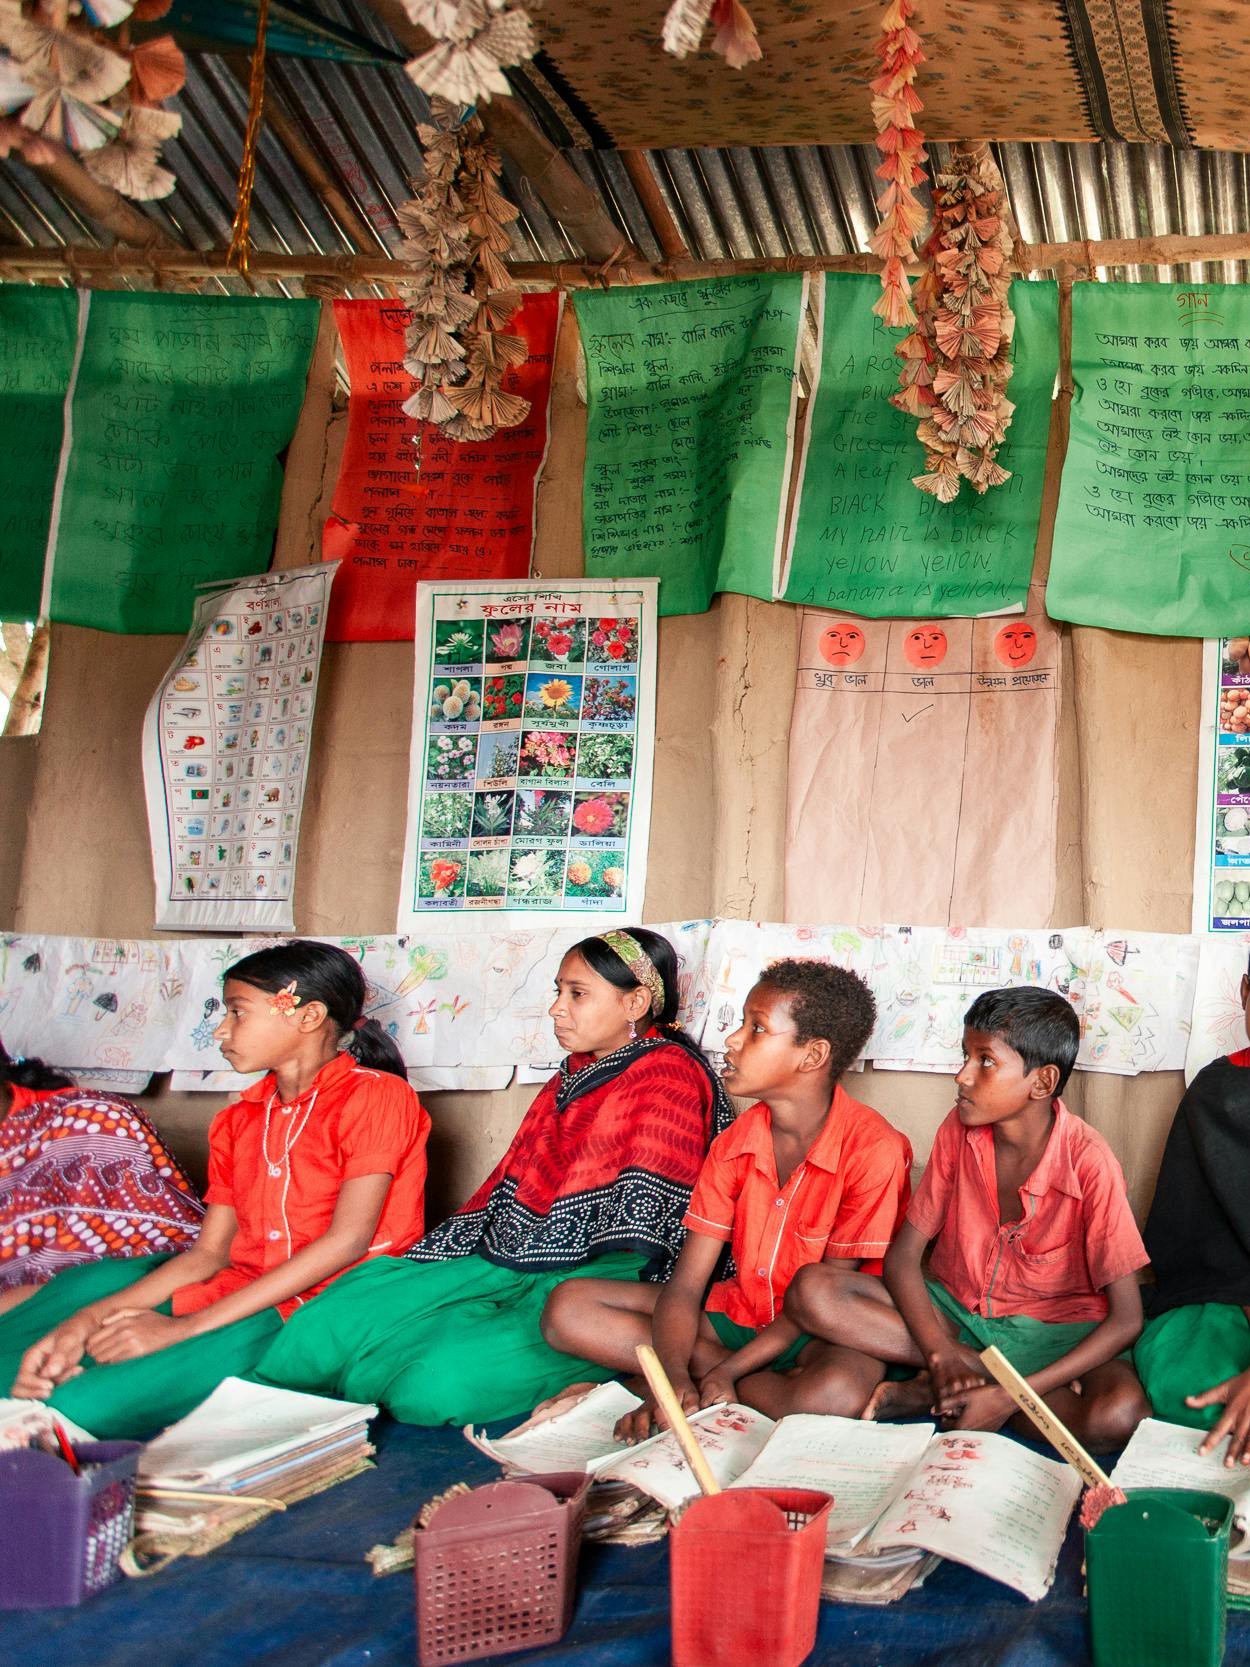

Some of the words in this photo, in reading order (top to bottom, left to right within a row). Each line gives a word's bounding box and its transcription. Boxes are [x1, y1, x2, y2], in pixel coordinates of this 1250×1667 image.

[1177, 292, 1212, 309] গান
[588, 333, 635, 360] স্কুলের
[682, 323, 707, 344] বালি
[1095, 332, 1140, 349] আমরা
[1143, 336, 1171, 349] করব
[1178, 338, 1199, 352] জয়
[1204, 338, 1240, 351] আমরা
[840, 355, 856, 375] A
[1099, 358, 1145, 375] আমরা
[1150, 364, 1180, 376] করব
[1183, 364, 1206, 377] জয়
[1096, 378, 1108, 392] ও
[1140, 385, 1172, 403] বুকের
[836, 409, 878, 426] The
[1098, 398, 1142, 418] আমরা
[1148, 408, 1184, 423] করবো
[1191, 410, 1213, 424] জয়
[1096, 419, 1152, 444] আমাদের
[1161, 425, 1183, 442] নেই
[1186, 430, 1211, 446] কোন
[1098, 438, 1122, 457] নেই
[1127, 448, 1161, 462] কোন
[834, 460, 849, 481] A
[853, 461, 899, 486] leaf
[1095, 460, 1151, 485] আমাদের
[1155, 468, 1181, 484] নেই
[1185, 473, 1216, 485] কোন
[1220, 473, 1245, 486] ভয়
[1083, 485, 1101, 499] ও
[1142, 492, 1177, 512] বুকের
[1187, 490, 1229, 511] গভীরে
[1085, 503, 1137, 528] আমরা
[1142, 514, 1185, 532] করবো
[1186, 516, 1213, 532] জয়
[824, 554, 899, 576] yellow
[503, 595, 530, 603] এসো
[535, 593, 563, 601] শিখি
[801, 586, 816, 600] A
[827, 585, 906, 602] banana
[913, 583, 932, 599] is
[480, 603, 535, 618] ফুলের
[544, 602, 582, 613] নাম
[443, 664, 474, 674] শাপলা
[546, 662, 568, 671] জবা
[594, 663, 631, 673] গোলাপ
[814, 673, 835, 689] খুব
[844, 674, 869, 687] ভাল
[911, 677, 937, 688] ভাল
[444, 723, 467, 732] কদম
[532, 719, 570, 730] সূর্যমুখী
[430, 780, 470, 790] নয়নতারা
[591, 778, 616, 788] বেলি
[430, 838, 461, 849] কামিনী
[580, 838, 616, 848] ডালিয়া
[425, 897, 459, 907] কলাবতী
